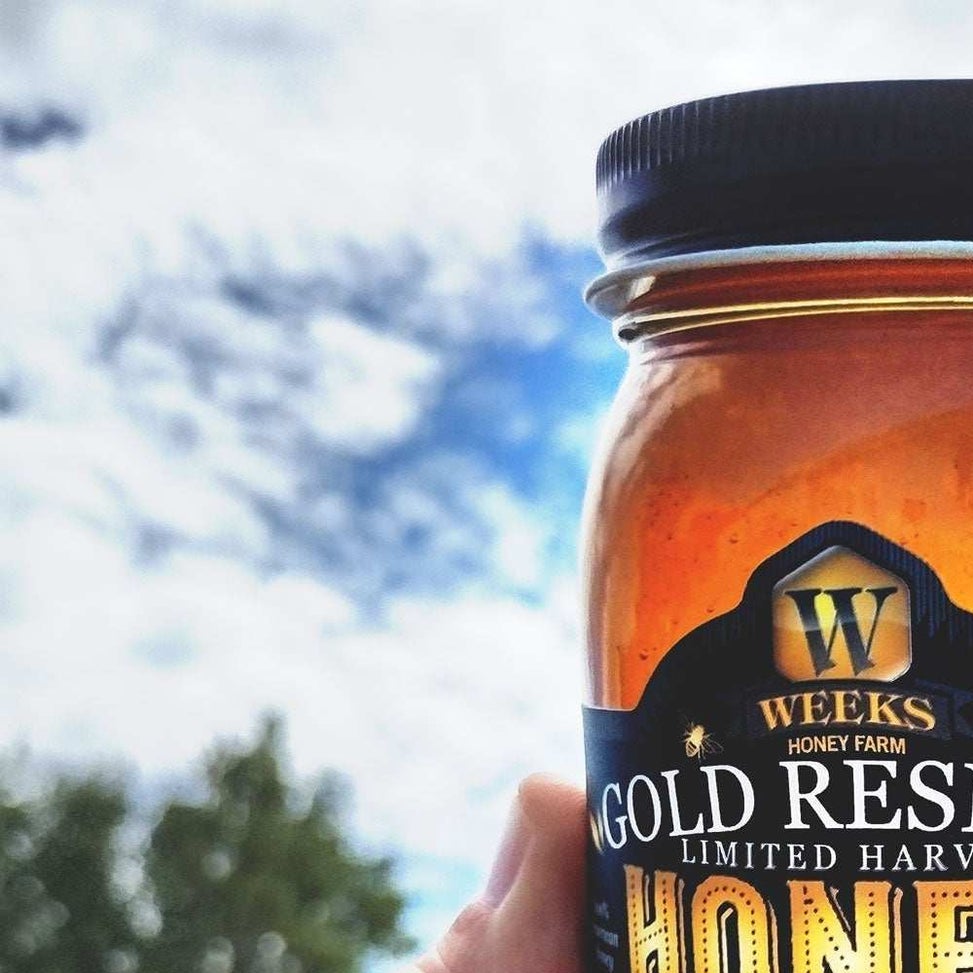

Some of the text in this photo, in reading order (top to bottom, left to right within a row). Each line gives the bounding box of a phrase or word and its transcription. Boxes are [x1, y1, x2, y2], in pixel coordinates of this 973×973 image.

[785, 586, 898, 678] W
[759, 689, 936, 732] WEEKS
[788, 735, 906, 754] HONEY FARM
[601, 764, 755, 849] GOLD
[682, 839, 837, 871] LIMITED
